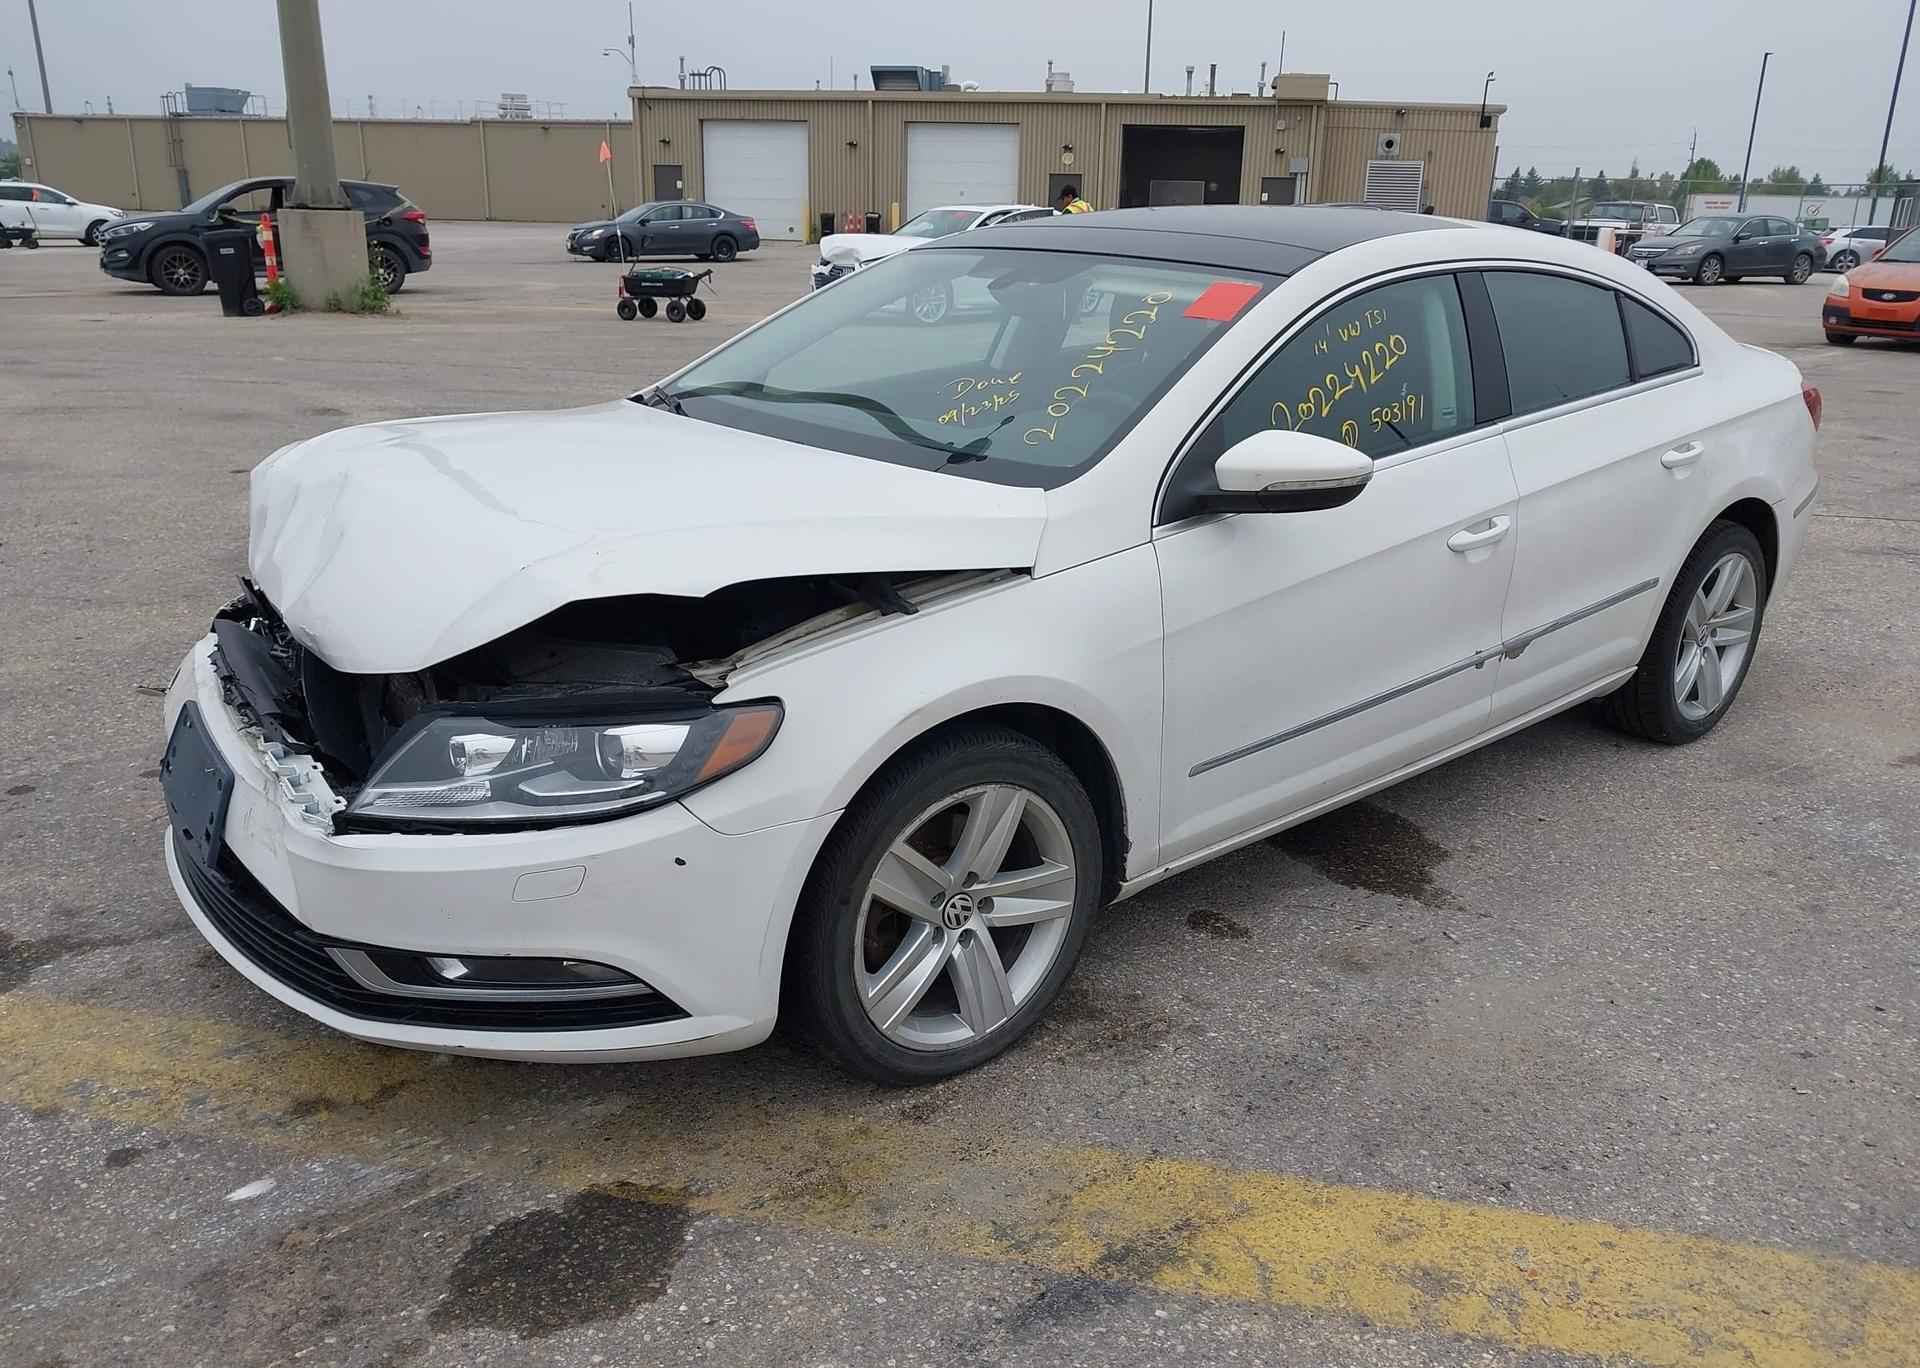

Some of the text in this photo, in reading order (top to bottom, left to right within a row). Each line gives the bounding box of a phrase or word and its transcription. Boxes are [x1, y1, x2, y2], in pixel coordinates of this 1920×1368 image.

[1338, 320, 1361, 342] VW
[1022, 290, 1173, 446] 20224220
[1270, 334, 1408, 432] 20224220
[938, 389, 1021, 427] 09/23/25
[1370, 394, 1424, 433] 503191
